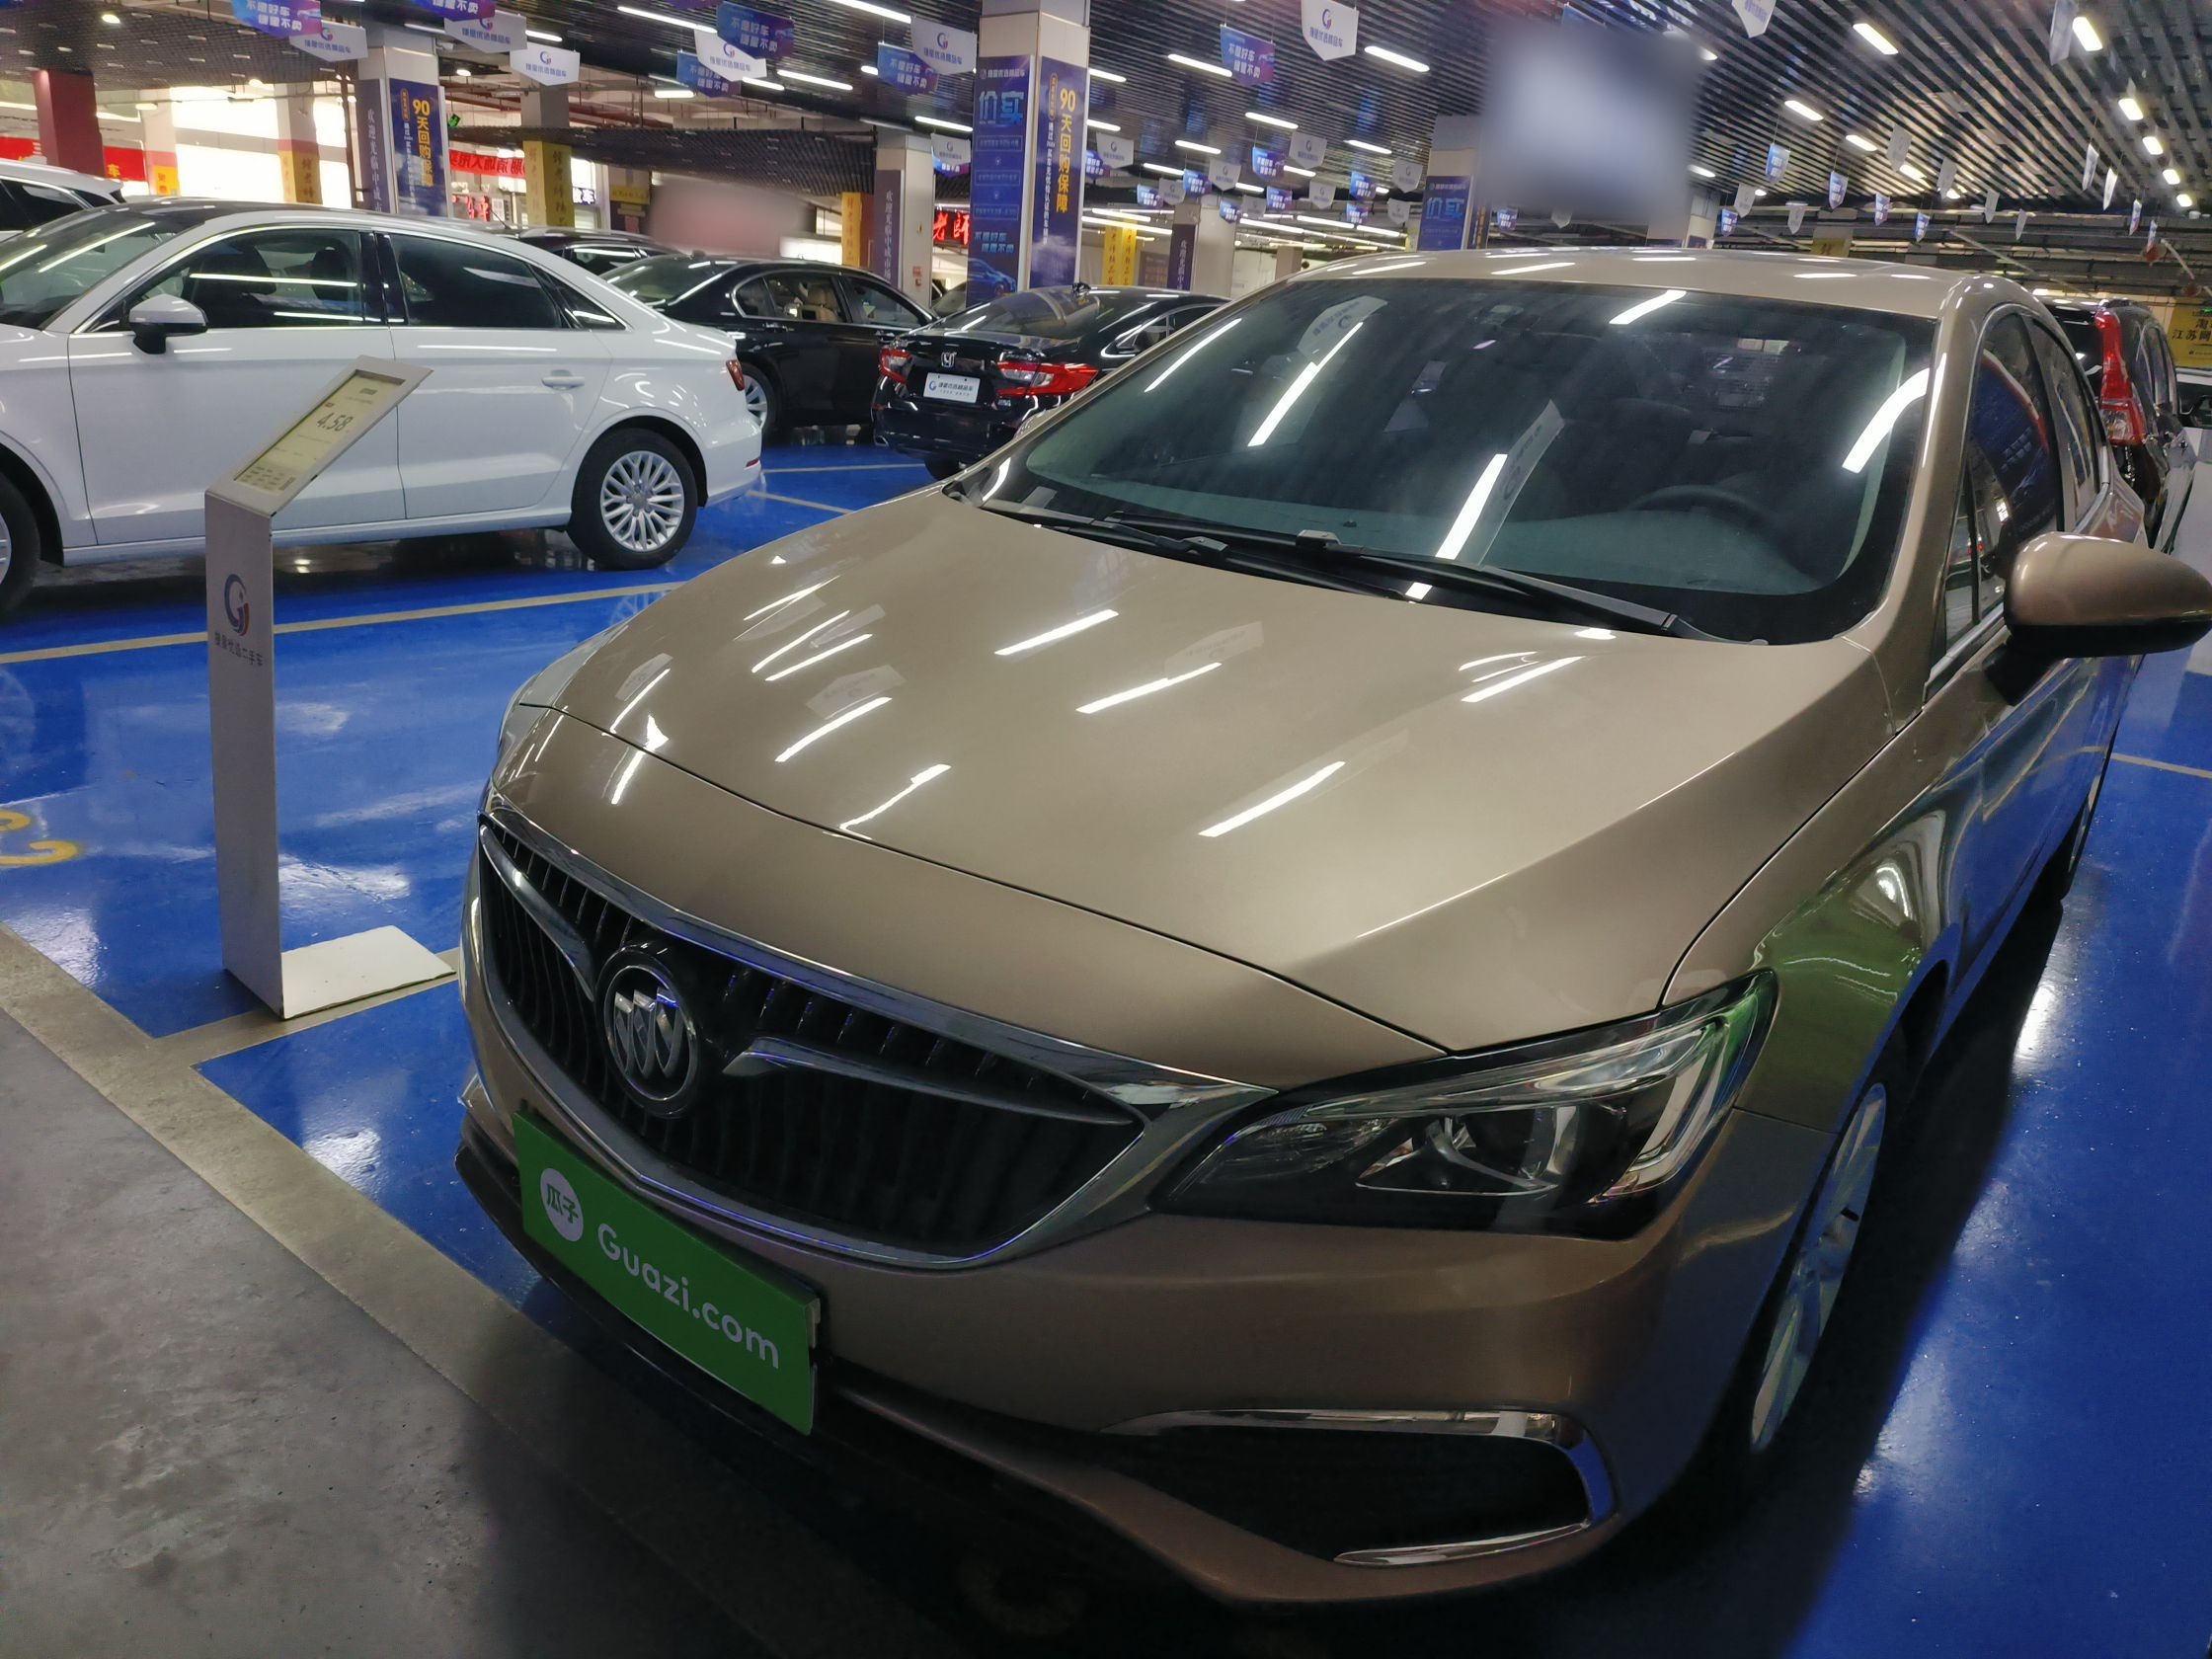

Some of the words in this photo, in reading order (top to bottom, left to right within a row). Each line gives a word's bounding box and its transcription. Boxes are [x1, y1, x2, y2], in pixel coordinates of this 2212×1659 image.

[316, 412, 355, 433] 4.58
[546, 1183, 580, 1224] 瓜子
[597, 1223, 780, 1370] Guazi.com
